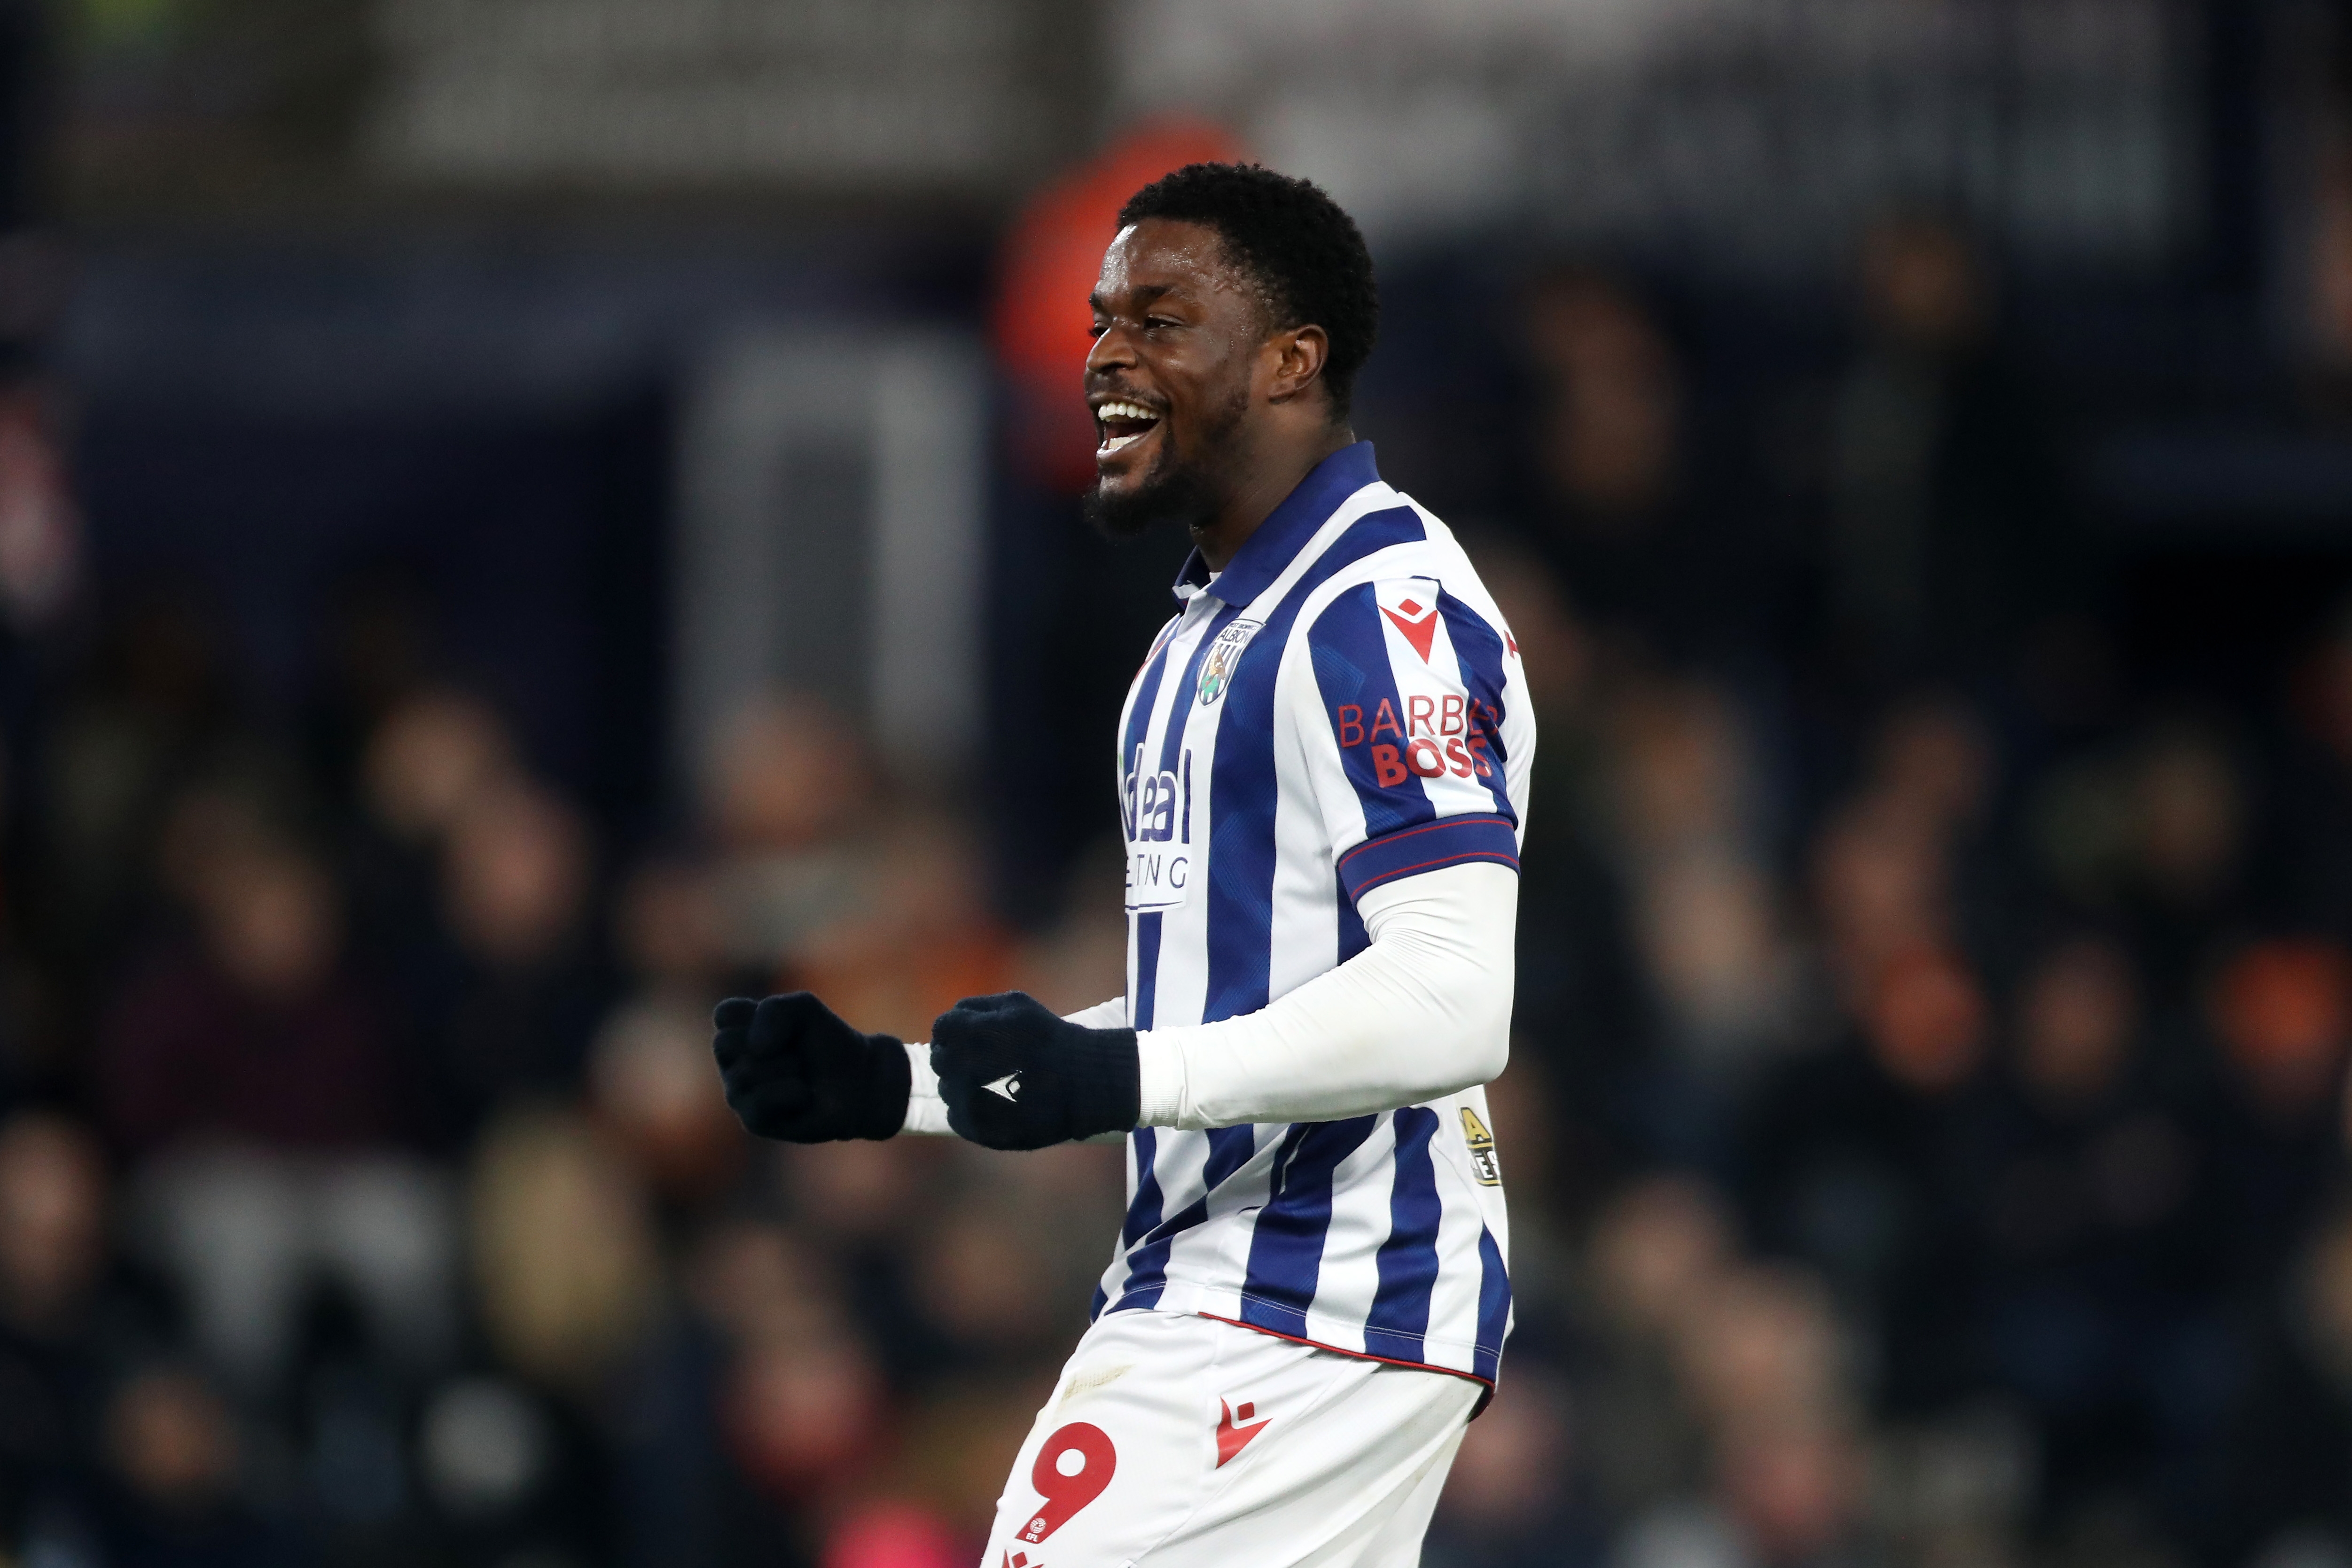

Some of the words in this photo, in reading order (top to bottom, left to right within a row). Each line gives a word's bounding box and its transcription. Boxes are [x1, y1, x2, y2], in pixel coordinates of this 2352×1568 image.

[1217, 628, 1252, 644] ALBION
[1371, 738, 1492, 789] BOSS
[1014, 1422, 1117, 1544] 9
[1025, 1532, 1038, 1543] EFL
